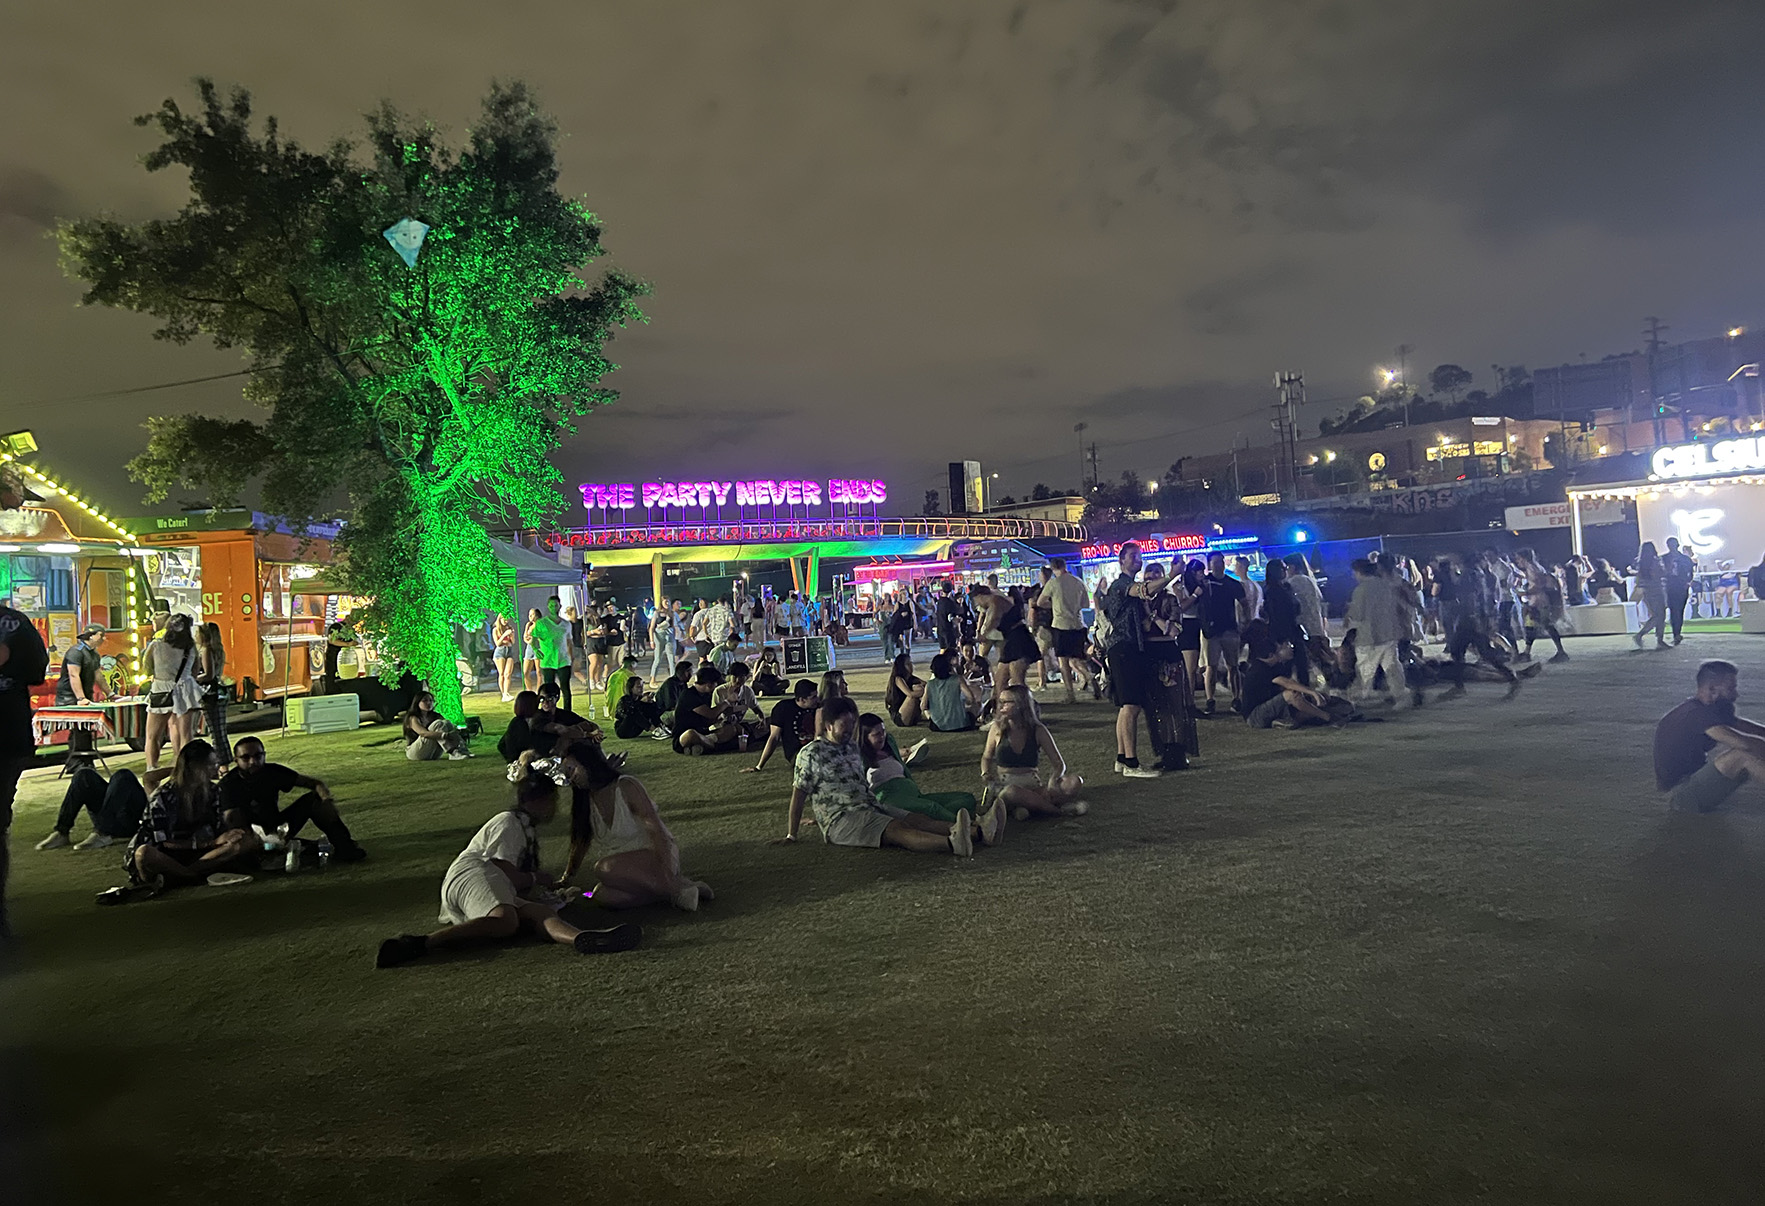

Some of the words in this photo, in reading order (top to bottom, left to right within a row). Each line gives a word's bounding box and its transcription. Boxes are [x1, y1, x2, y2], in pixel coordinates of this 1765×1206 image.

[579, 482, 635, 508] THE
[641, 481, 732, 507] PARTY
[735, 479, 821, 506] NEVER
[828, 478, 887, 504] ENDS
[1524, 501, 1600, 517] EMERGCY
[156, 518, 167, 528] We
[1081, 544, 1110, 559] FRO-YO
[1113, 540, 1160, 556] SHIES
[1163, 535, 1206, 551] CHURROS
[202, 592, 224, 615] SE
